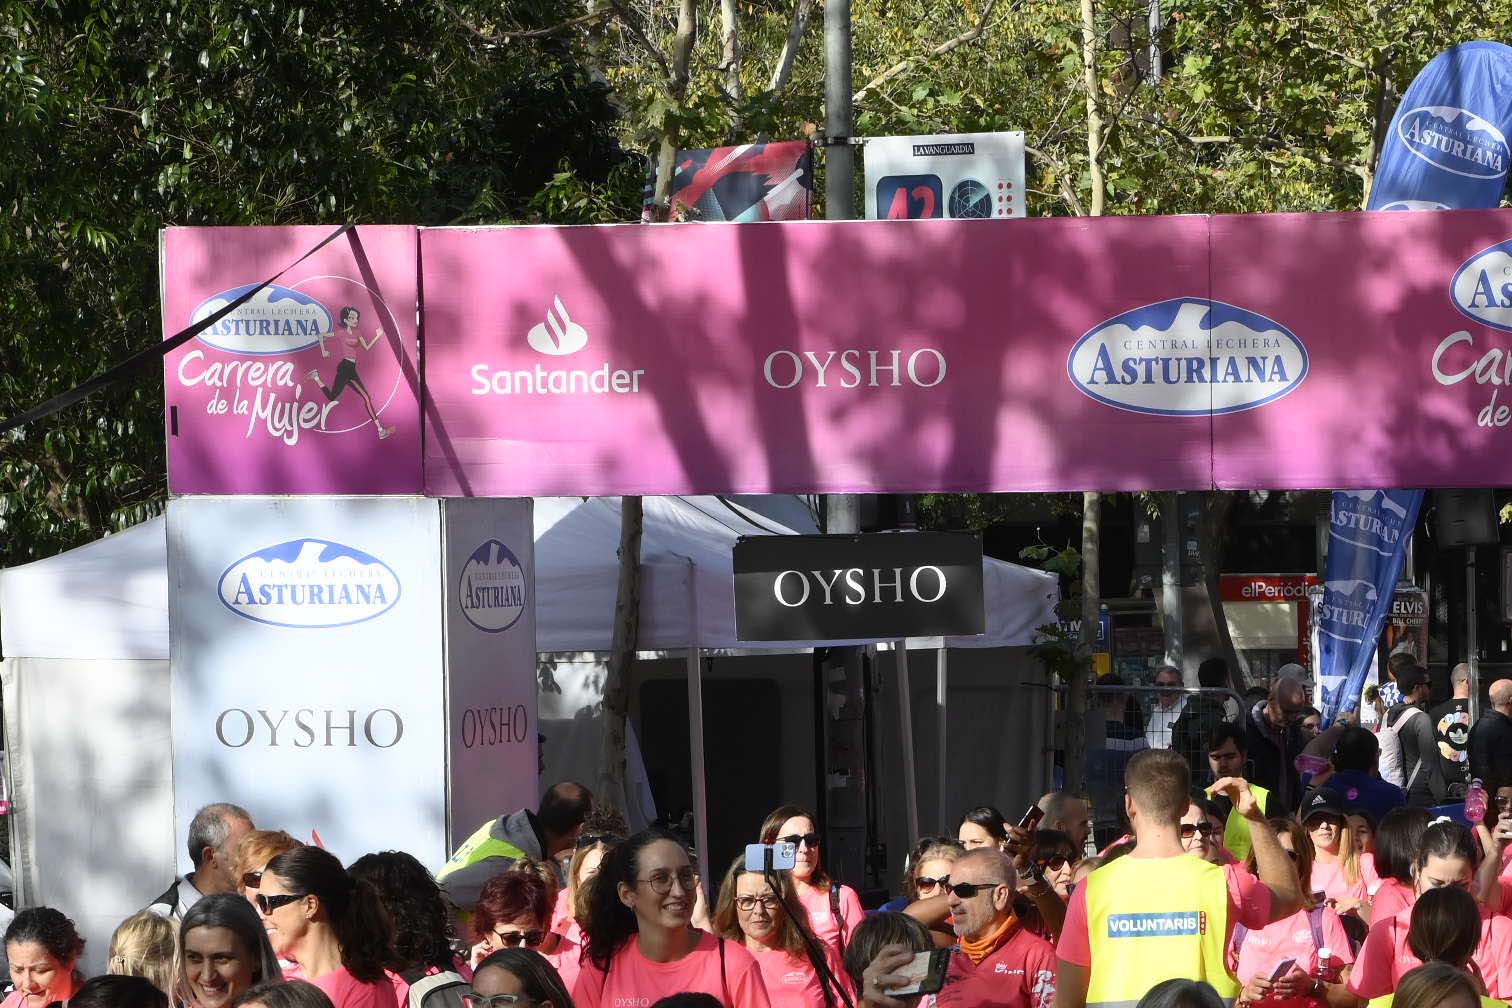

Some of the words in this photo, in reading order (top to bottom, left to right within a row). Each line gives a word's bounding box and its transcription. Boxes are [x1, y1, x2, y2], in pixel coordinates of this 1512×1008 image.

[1405, 117, 1502, 171] ASTURIANA
[202, 314, 321, 336] ASTURIANA
[229, 307, 268, 316] ENTRAL
[1124, 339, 1203, 350] CENTRAL
[1206, 337, 1282, 349] LECHERA
[178, 350, 295, 387] Carrera
[471, 362, 645, 394] Santander
[763, 349, 947, 389] OYSHO
[1087, 342, 1289, 385] ASTURIANA
[206, 388, 228, 414] de
[233, 388, 249, 414] la
[247, 384, 340, 446] Mujer
[1477, 389, 1511, 428] de
[232, 572, 388, 606] ASTURIANA
[465, 574, 522, 610] ASTURIANA
[773, 565, 947, 608] OYSHO
[1392, 600, 1424, 613] ELVIS
[215, 708, 404, 748] OYSHO
[462, 704, 527, 748] OYSHO
[1109, 917, 1197, 932] VOLUNTARIS
